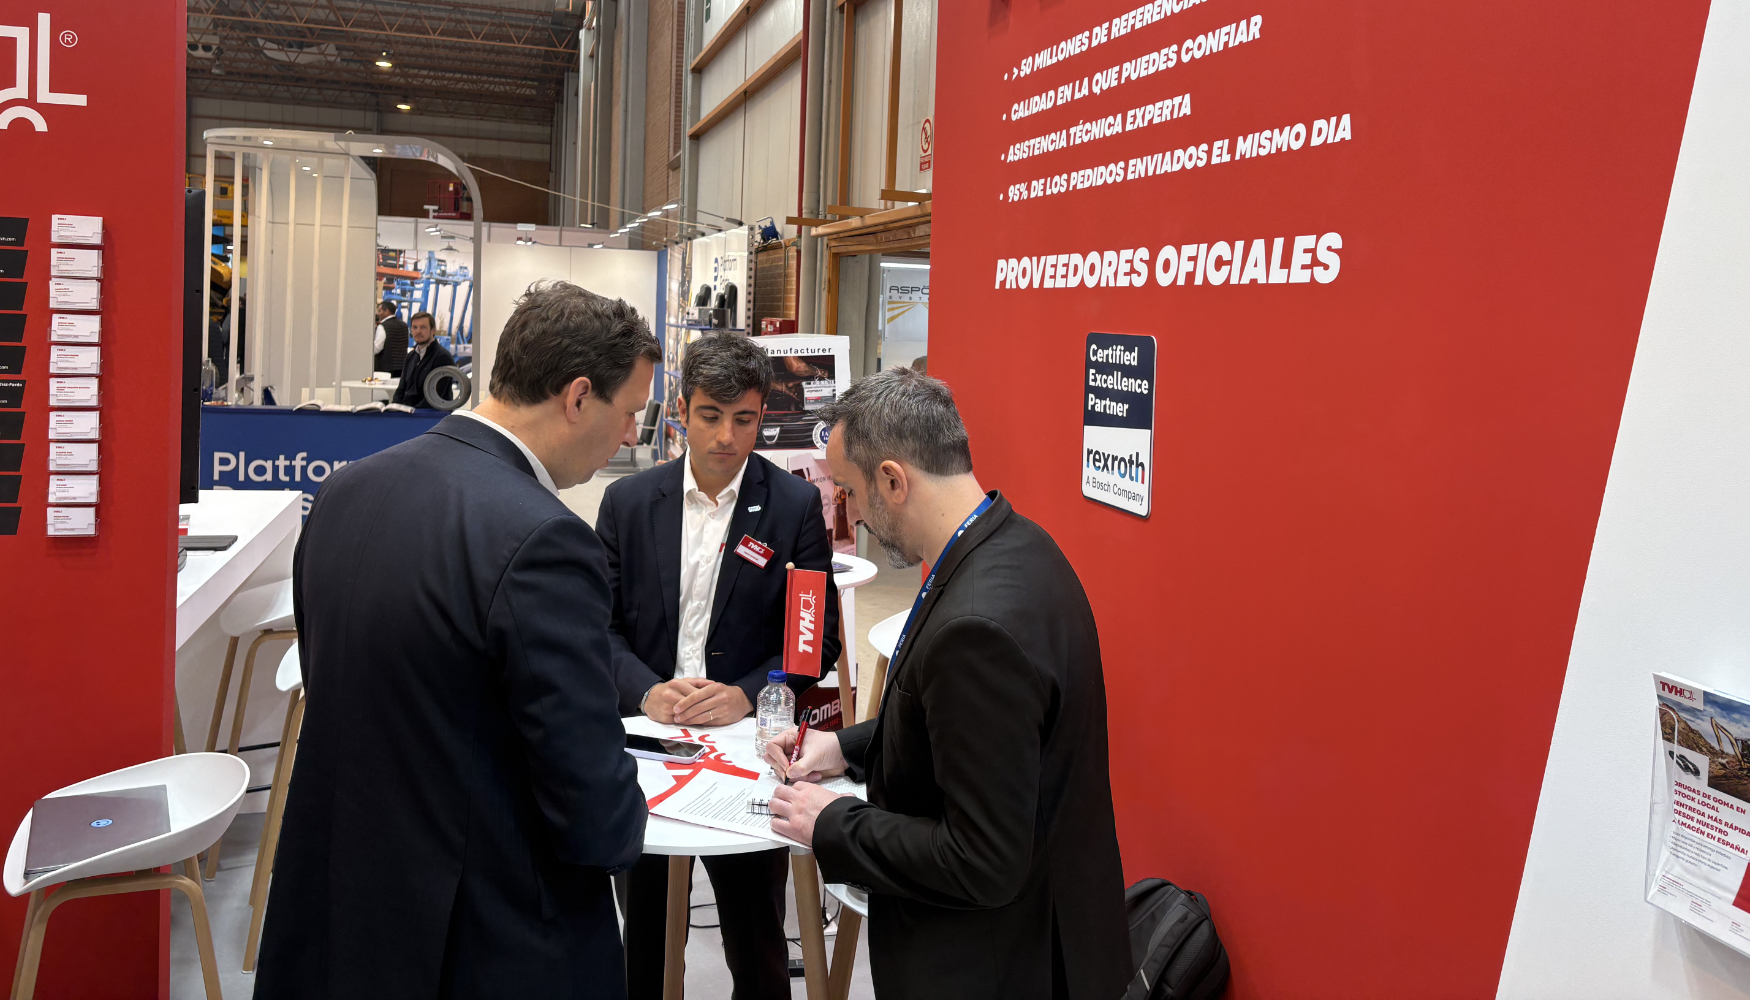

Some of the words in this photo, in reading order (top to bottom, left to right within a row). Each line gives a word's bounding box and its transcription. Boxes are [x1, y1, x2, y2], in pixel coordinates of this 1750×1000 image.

[1033, 30, 1089, 72] MILLONES
[1091, 22, 1109, 48] DE
[1110, 0, 1208, 40] REFERENCIA
[1011, 90, 1056, 121] CALIDAD
[1056, 84, 1072, 105] EN
[1074, 77, 1089, 99] LA
[1091, 66, 1119, 96] QUE
[1120, 44, 1178, 83] PUEDES
[1180, 14, 1263, 64] CONFIAR
[1006, 130, 1067, 163] ASISTENCIA
[1069, 114, 1122, 147] TÉCNICA
[1125, 93, 1192, 132] EXPERTA
[1008, 182, 1029, 203] 95%
[1030, 176, 1045, 199] DE
[1046, 173, 1068, 195] LOS
[1069, 161, 1125, 191] PEDIDOS
[1127, 143, 1208, 181] ENVIADOS
[1210, 139, 1231, 165] EL
[1234, 123, 1307, 160] MISMO
[1310, 114, 1352, 147] DIA
[995, 246, 1150, 290] PROVEEDORES
[1154, 232, 1343, 287] OFICIALES
[1089, 343, 1138, 367] Certified
[1088, 368, 1149, 395] Excellence
[1088, 393, 1129, 418] Partner
[1086, 447, 1145, 485] rexroth
[1085, 475, 1092, 487] A
[1092, 476, 1111, 494] Bosch
[1112, 482, 1145, 506] Company
[963, 513, 979, 528] FERIA
[798, 610, 816, 654] TVH
[1659, 681, 1683, 698] TVH
[1674, 789, 1696, 804] STOCK
[1697, 798, 1720, 813] LOCAL
[1702, 791, 1712, 800] DE
[1712, 796, 1735, 811] GOMA
[1735, 806, 1747, 816] EN
[1674, 809, 1695, 823] DESDE
[1696, 818, 1729, 837] NUESTRO
[1707, 812, 1723, 825] MÁS
[1706, 832, 1717, 842] EN
[1717, 835, 1749, 856] ESPAÑA!
